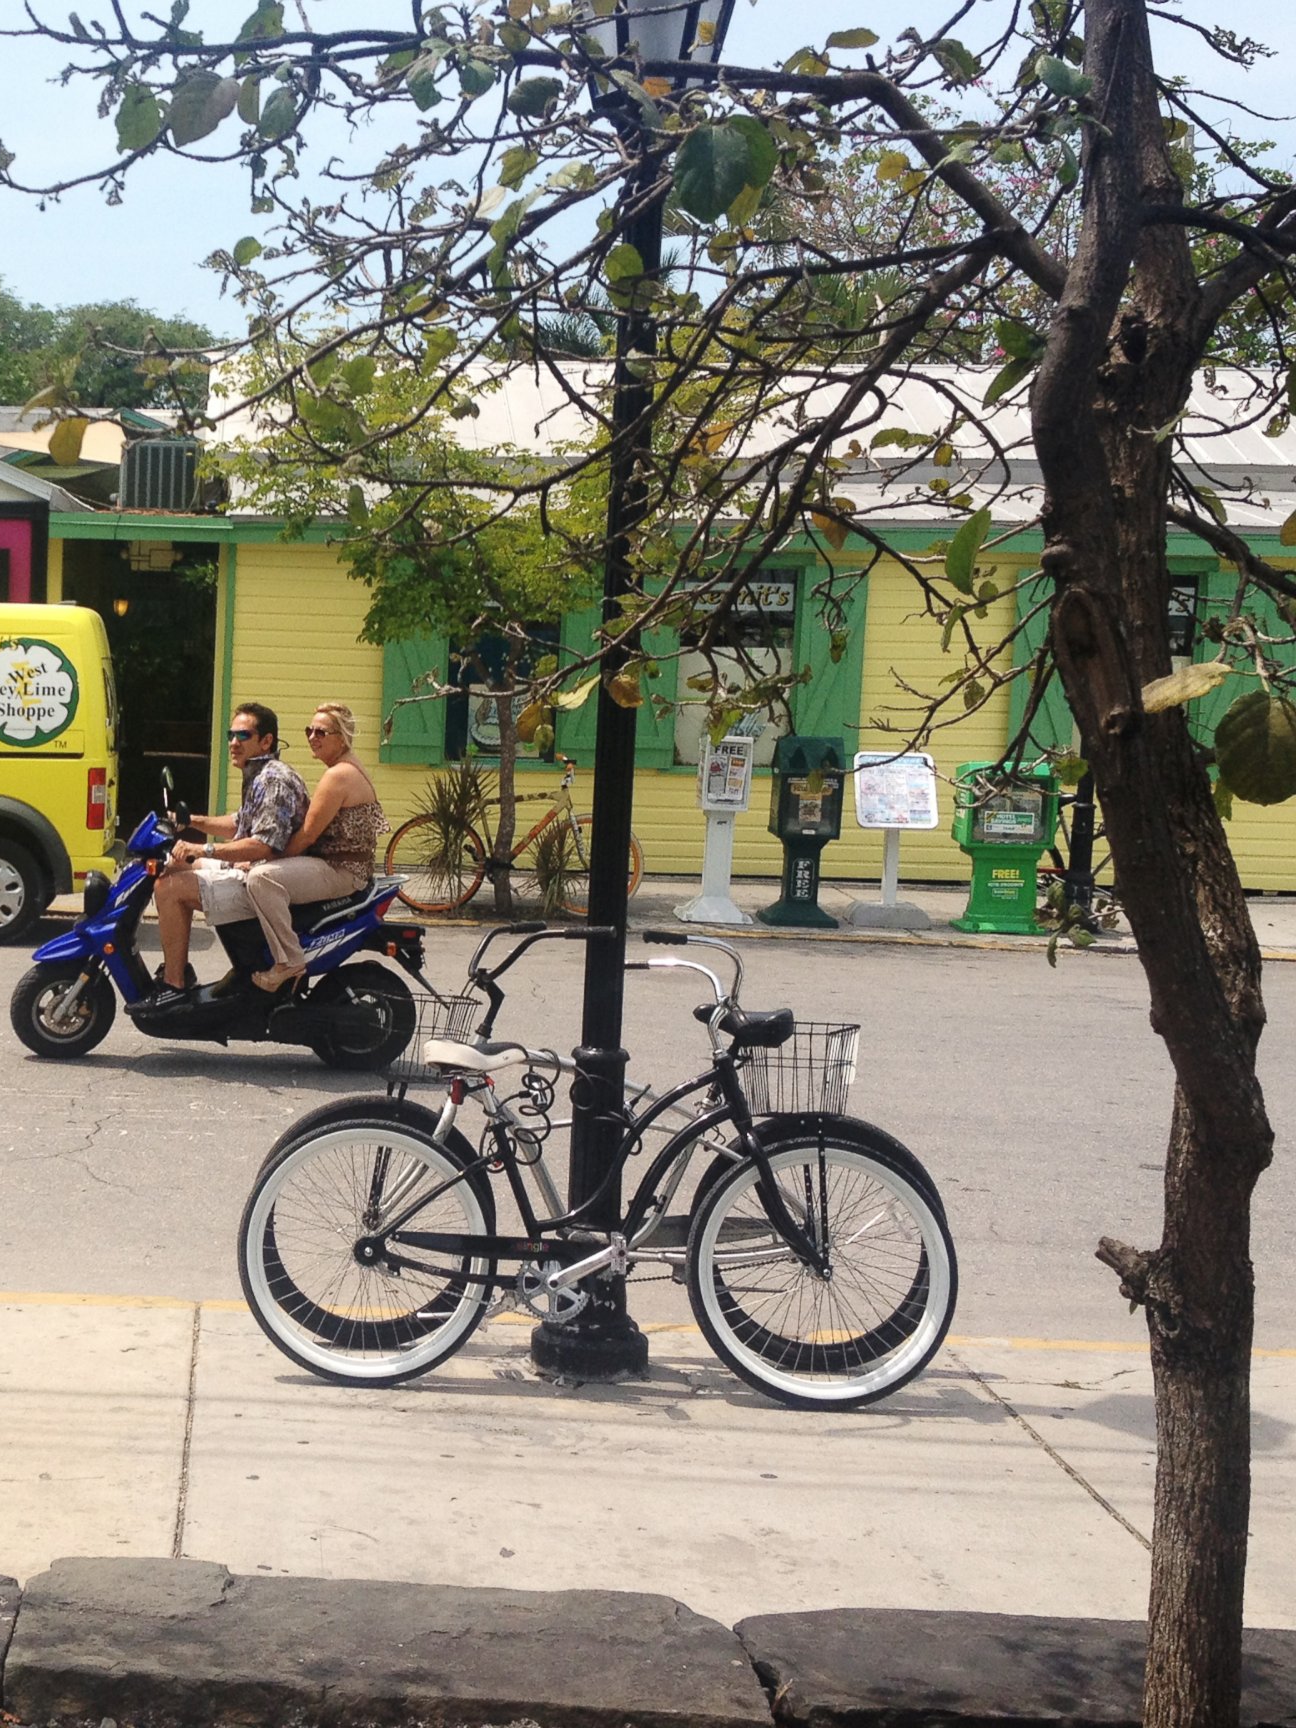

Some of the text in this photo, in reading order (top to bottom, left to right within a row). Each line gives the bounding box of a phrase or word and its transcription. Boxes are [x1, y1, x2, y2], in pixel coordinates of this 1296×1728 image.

[8, 662, 48, 684] West
[23, 682, 66, 697] Lime
[54, 740, 68, 750] TM
[715, 745, 744, 756] FREE
[795, 860, 811, 898] FREE
[992, 869, 1020, 879] FREE!
